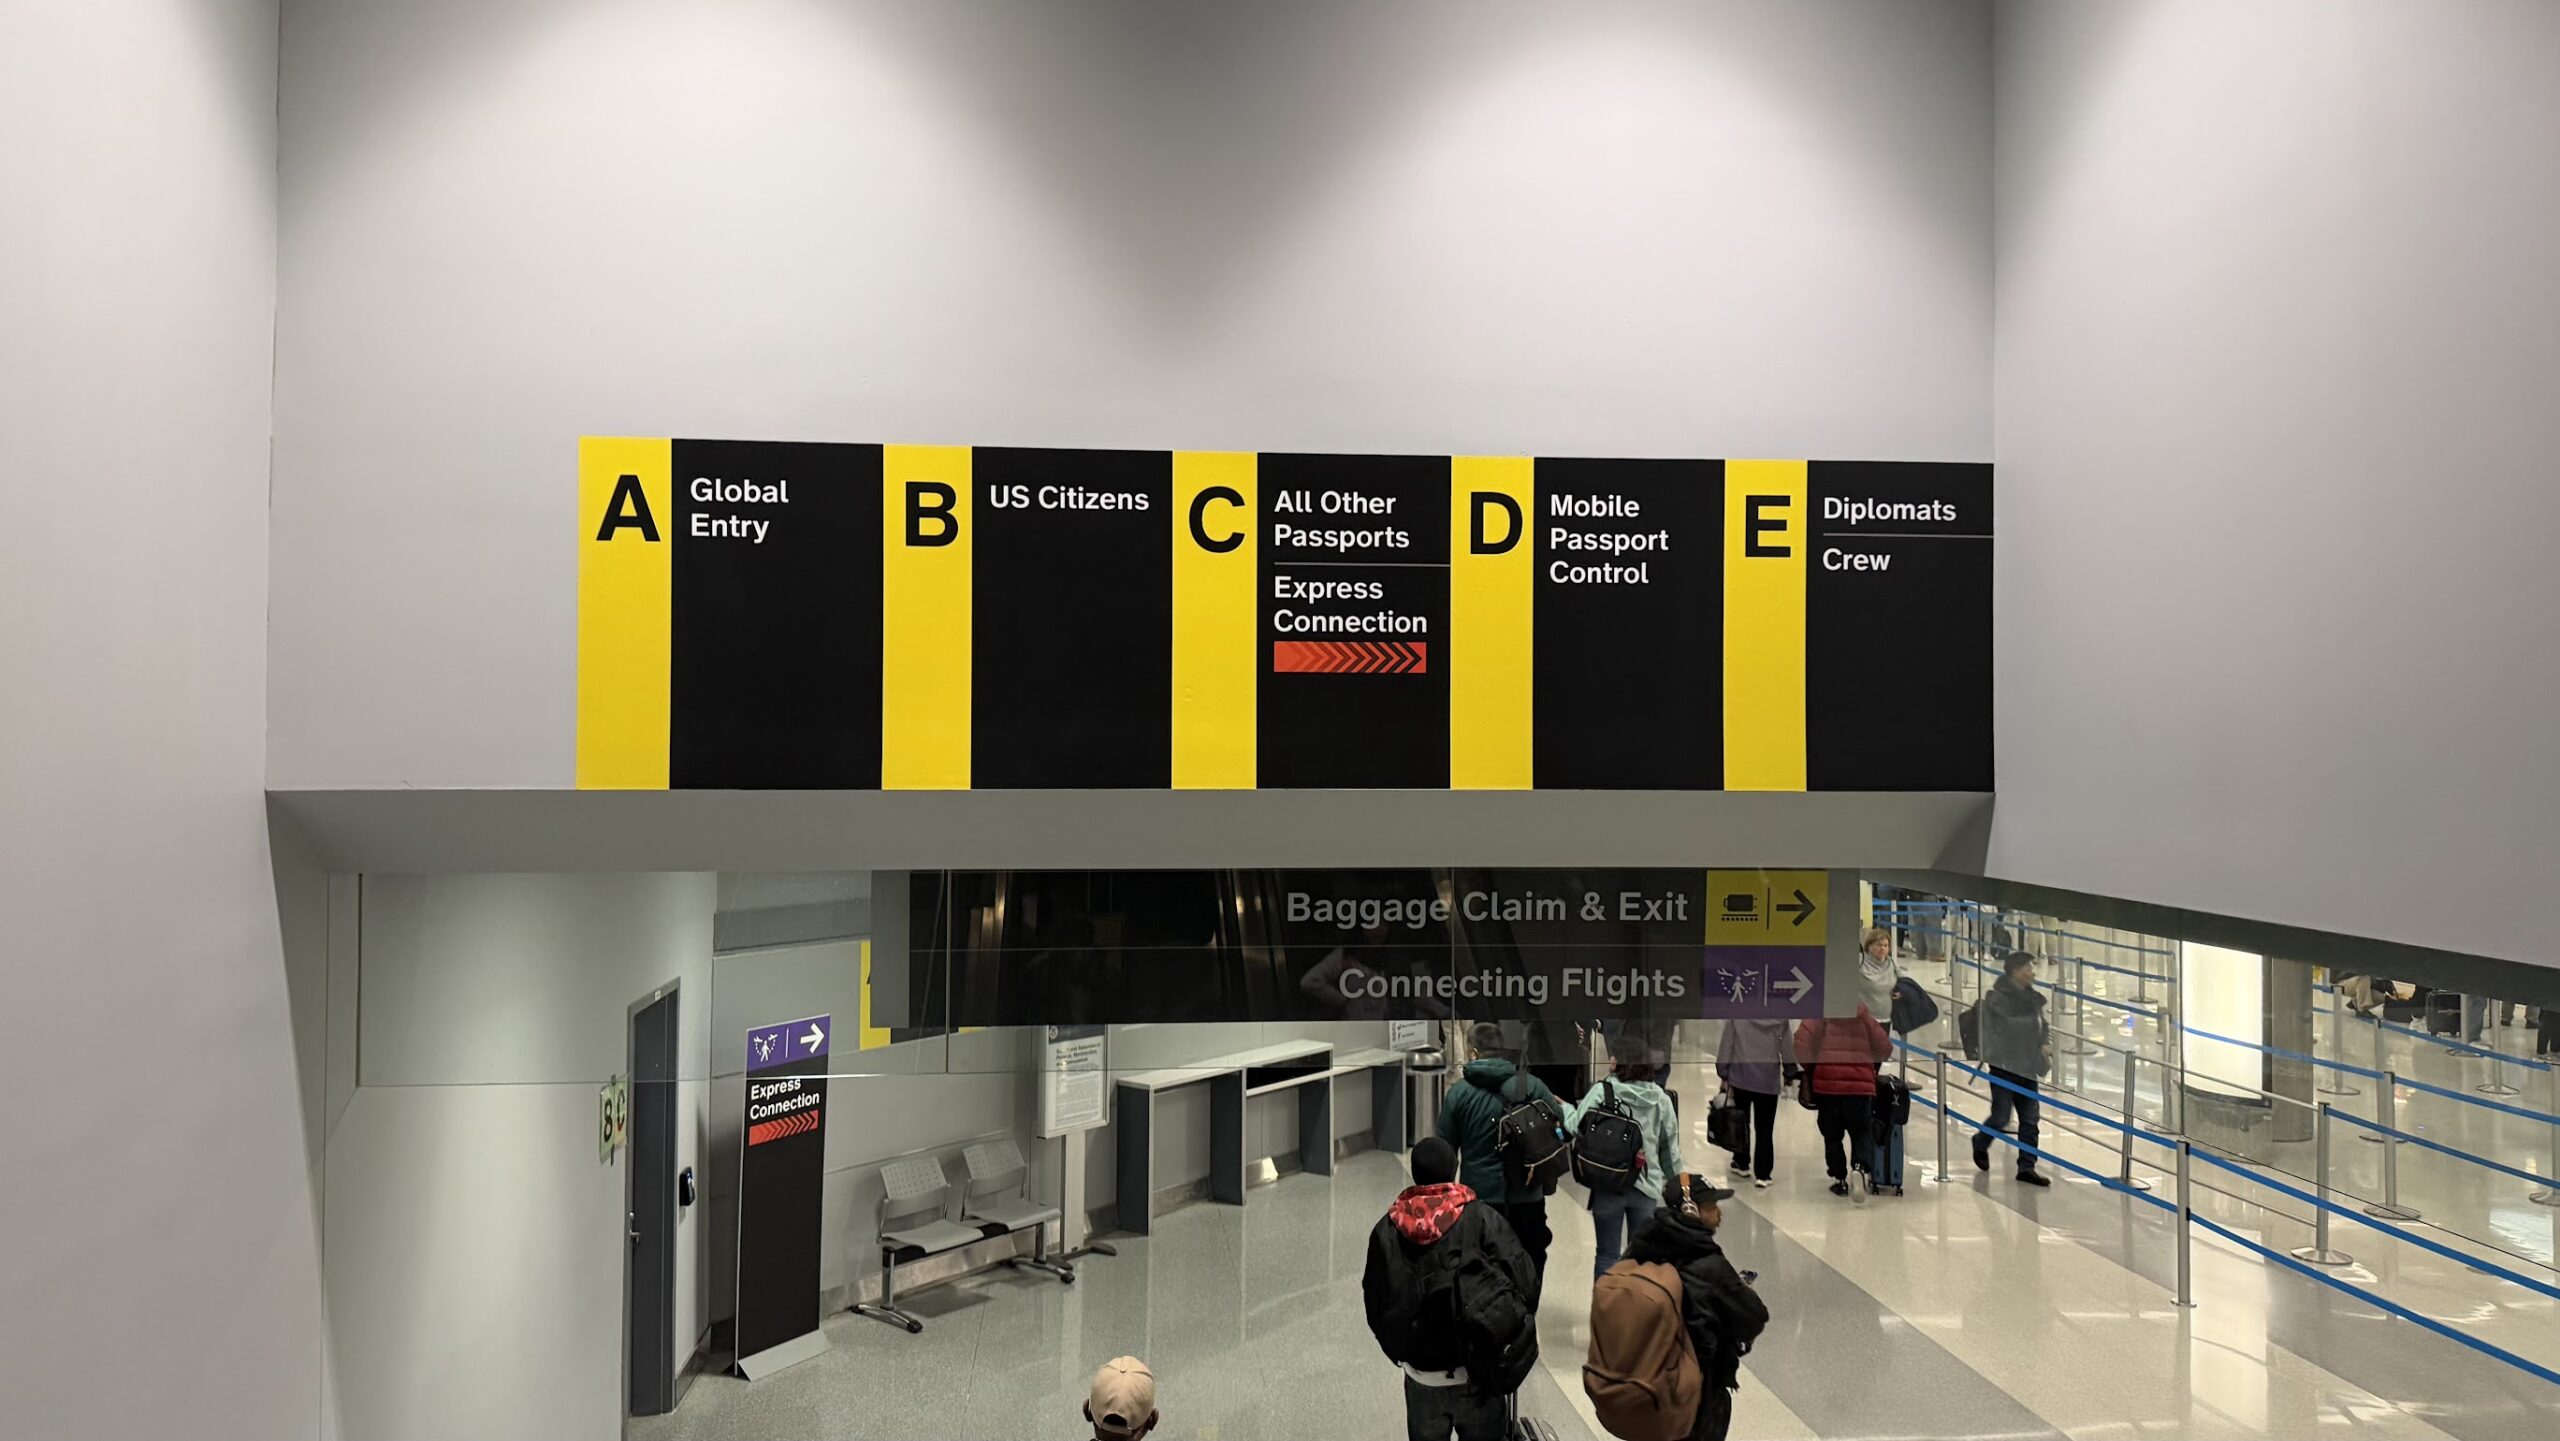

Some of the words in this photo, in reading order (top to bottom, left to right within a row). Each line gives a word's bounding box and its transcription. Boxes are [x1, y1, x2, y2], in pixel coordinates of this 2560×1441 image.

[690, 477, 790, 504] Global
[990, 484, 1030, 509] US
[1038, 485, 1150, 511] Citizens
[1273, 489, 1313, 513] All
[1320, 490, 1397, 515] Other
[1550, 493, 1640, 518] Mobile
[596, 474, 661, 542] A
[905, 481, 959, 547] B
[1188, 485, 1246, 554] C
[1470, 491, 1523, 555] D
[1823, 496, 1957, 526] Diplomats
[691, 512, 770, 544] Entry
[1274, 523, 1410, 553] Passports
[1744, 494, 1791, 558] E
[1550, 527, 1669, 557] Passport
[1549, 560, 1650, 585] Control
[1822, 547, 1891, 571] Crew
[1274, 575, 1384, 605] Express
[1273, 608, 1428, 634] Connection
[1286, 892, 1451, 930] Baggage
[1463, 890, 1567, 922] Claim
[1580, 891, 1607, 922] &
[1619, 890, 1689, 922] Exit
[1339, 968, 1549, 1005] Connecting
[1561, 966, 1686, 1006] Flights
[751, 1078, 802, 1101] Express
[750, 1092, 820, 1120] Connection
